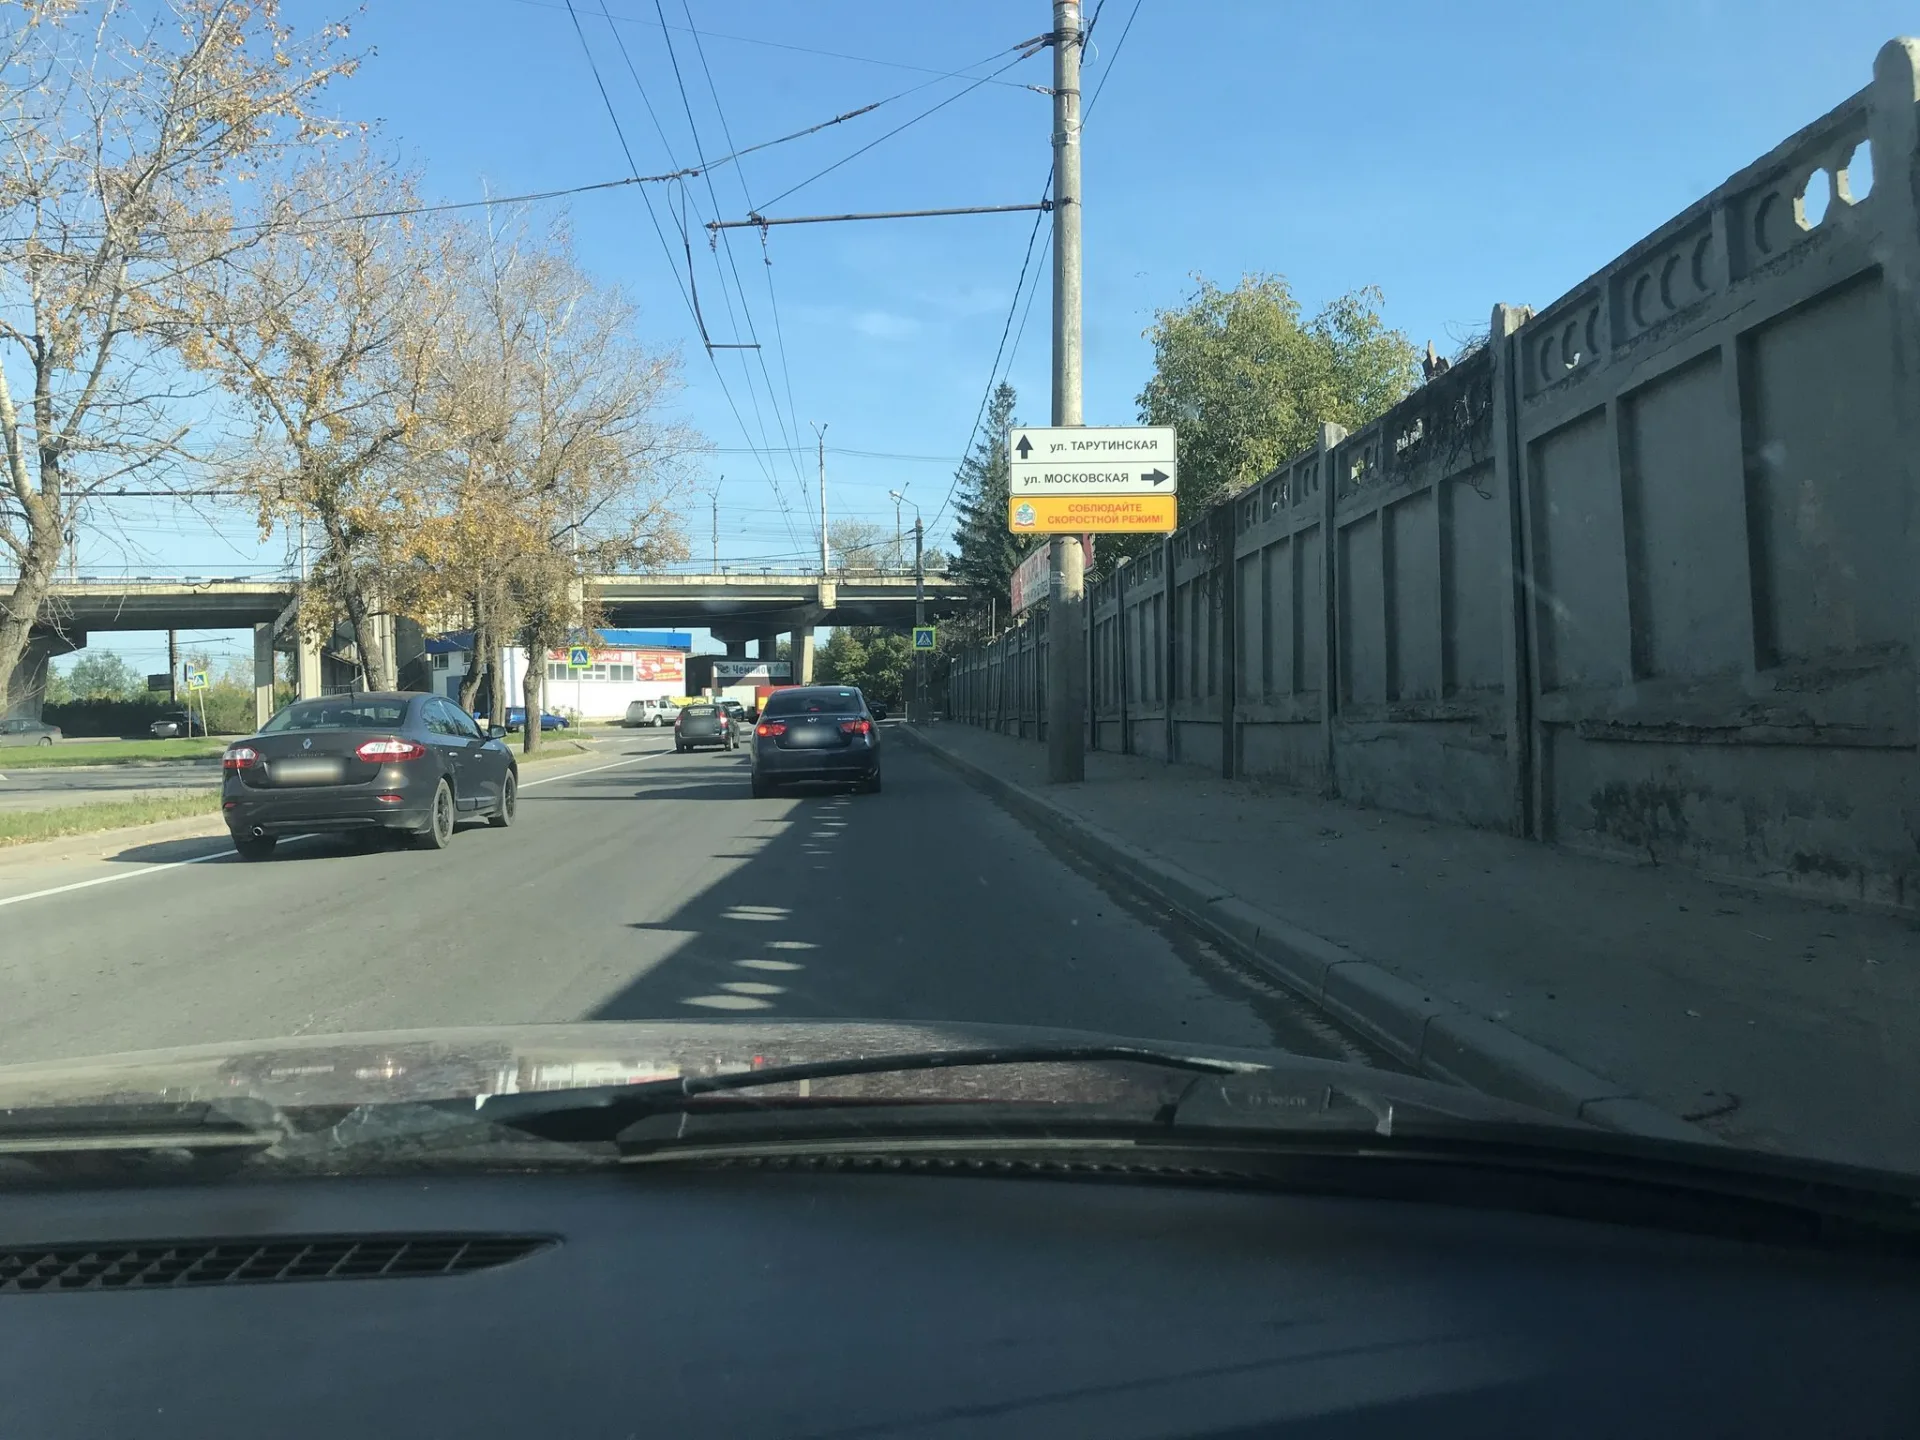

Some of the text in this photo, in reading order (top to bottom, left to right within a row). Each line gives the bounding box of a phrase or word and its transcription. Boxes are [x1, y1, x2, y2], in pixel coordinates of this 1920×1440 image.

[1050, 440, 1158, 453] ул. ТАРУТИНСКАЯ
[1024, 473, 1129, 486] ул. МОСКОВСКАЯ
[1068, 502, 1142, 512] СОБЛЮДАЙТЕ
[1048, 514, 1163, 524] СКОРОСТНОЙ РЕЖИМ!
